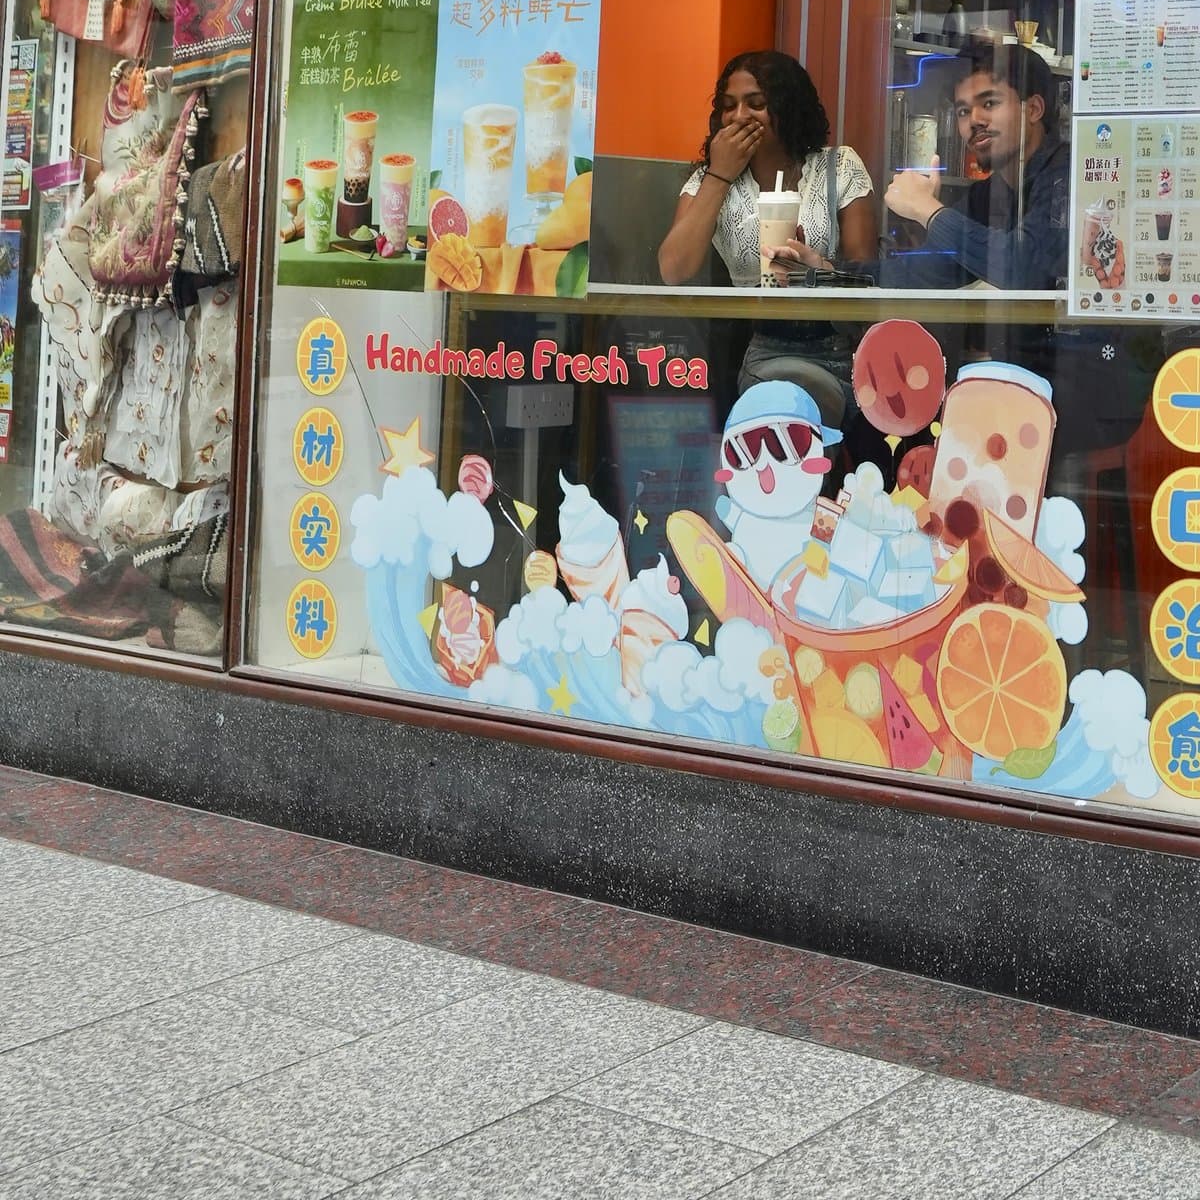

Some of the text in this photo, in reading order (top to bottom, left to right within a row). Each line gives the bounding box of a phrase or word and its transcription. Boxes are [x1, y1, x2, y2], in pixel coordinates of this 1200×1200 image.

[342, 64, 402, 92] Brûlée
[366, 332, 708, 391] Handmade Fresh Tea
